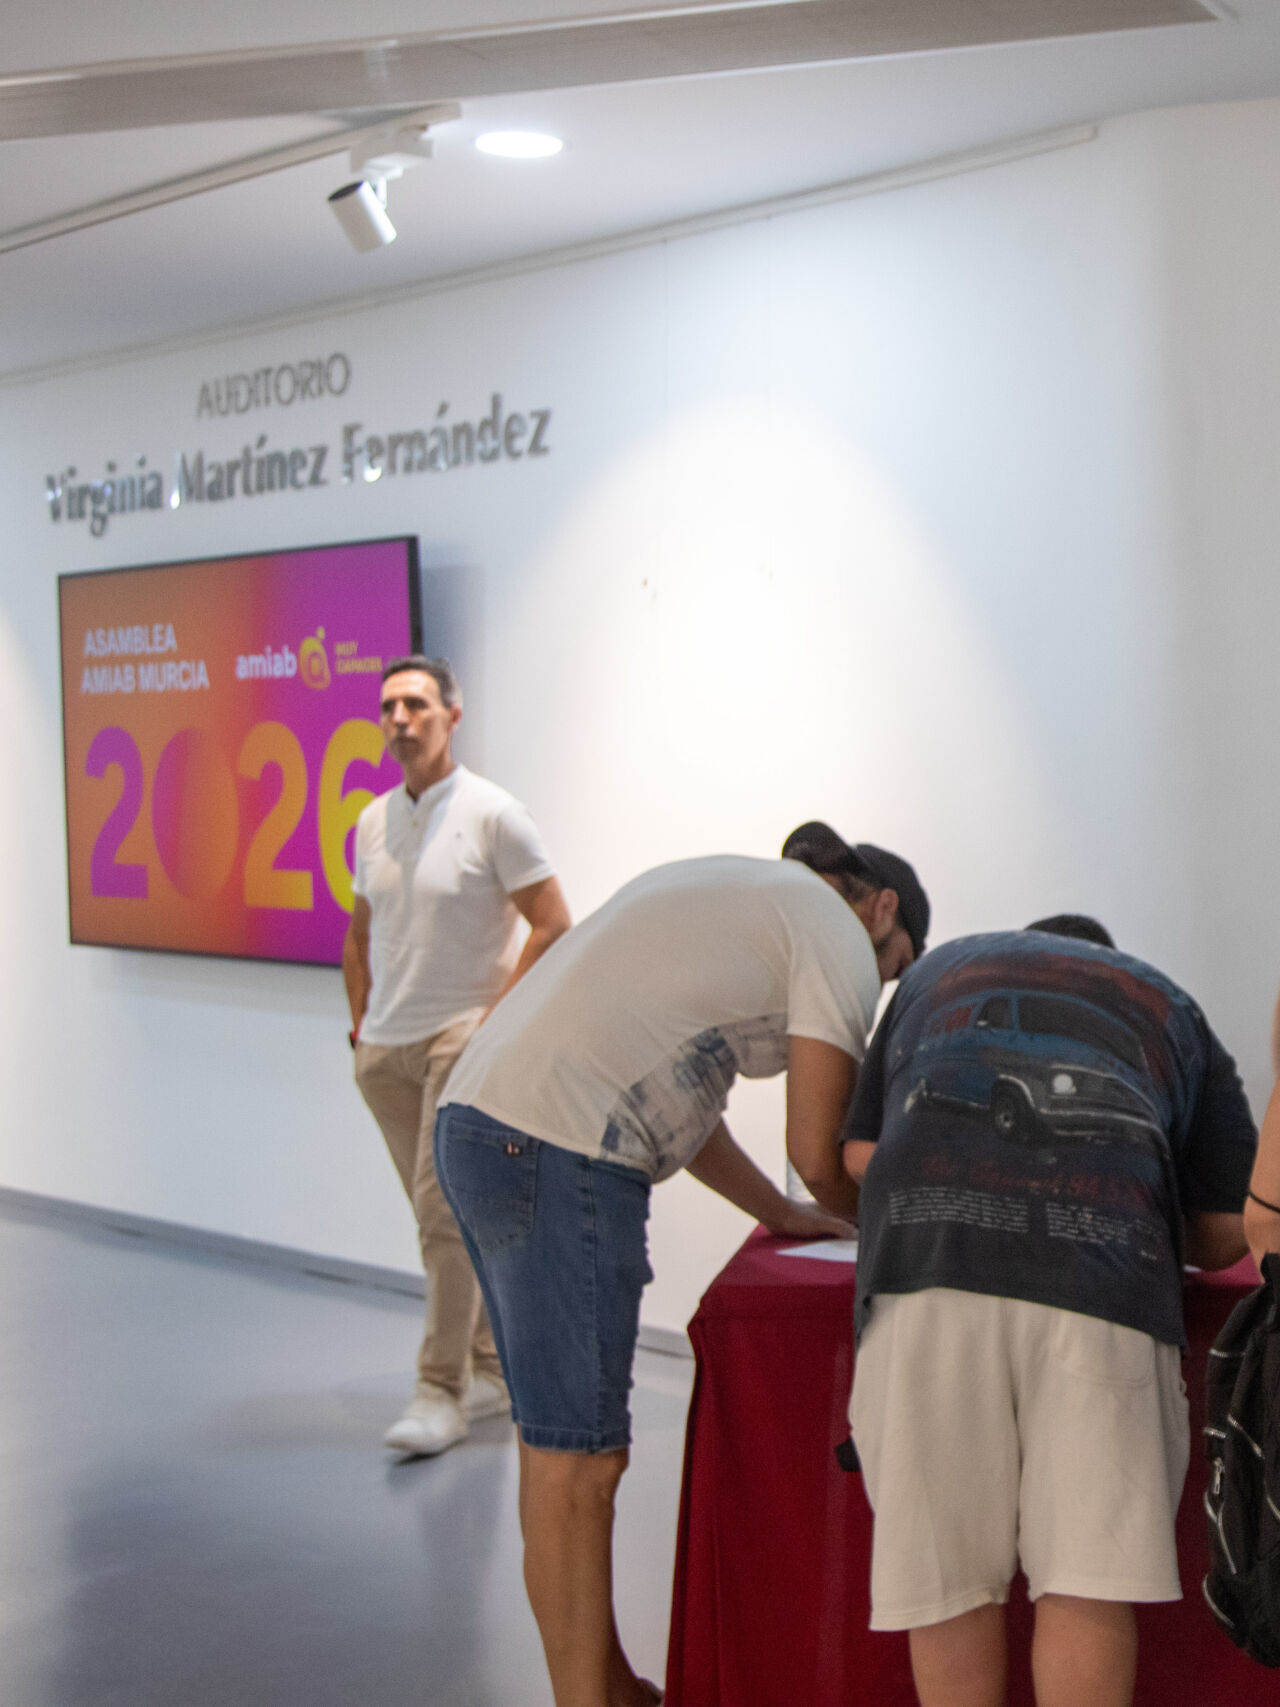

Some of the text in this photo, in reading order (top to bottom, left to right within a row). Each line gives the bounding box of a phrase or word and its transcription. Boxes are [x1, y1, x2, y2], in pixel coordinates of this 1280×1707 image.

[196, 352, 352, 418] AUDITORIO
[46, 393, 552, 537] Virginia Martínez Fernández
[84, 623, 177, 658] ASAMBLEA
[235, 645, 297, 679] amiab
[81, 660, 210, 694] AMIAB MURCIA
[85, 718, 386, 915] 2026
